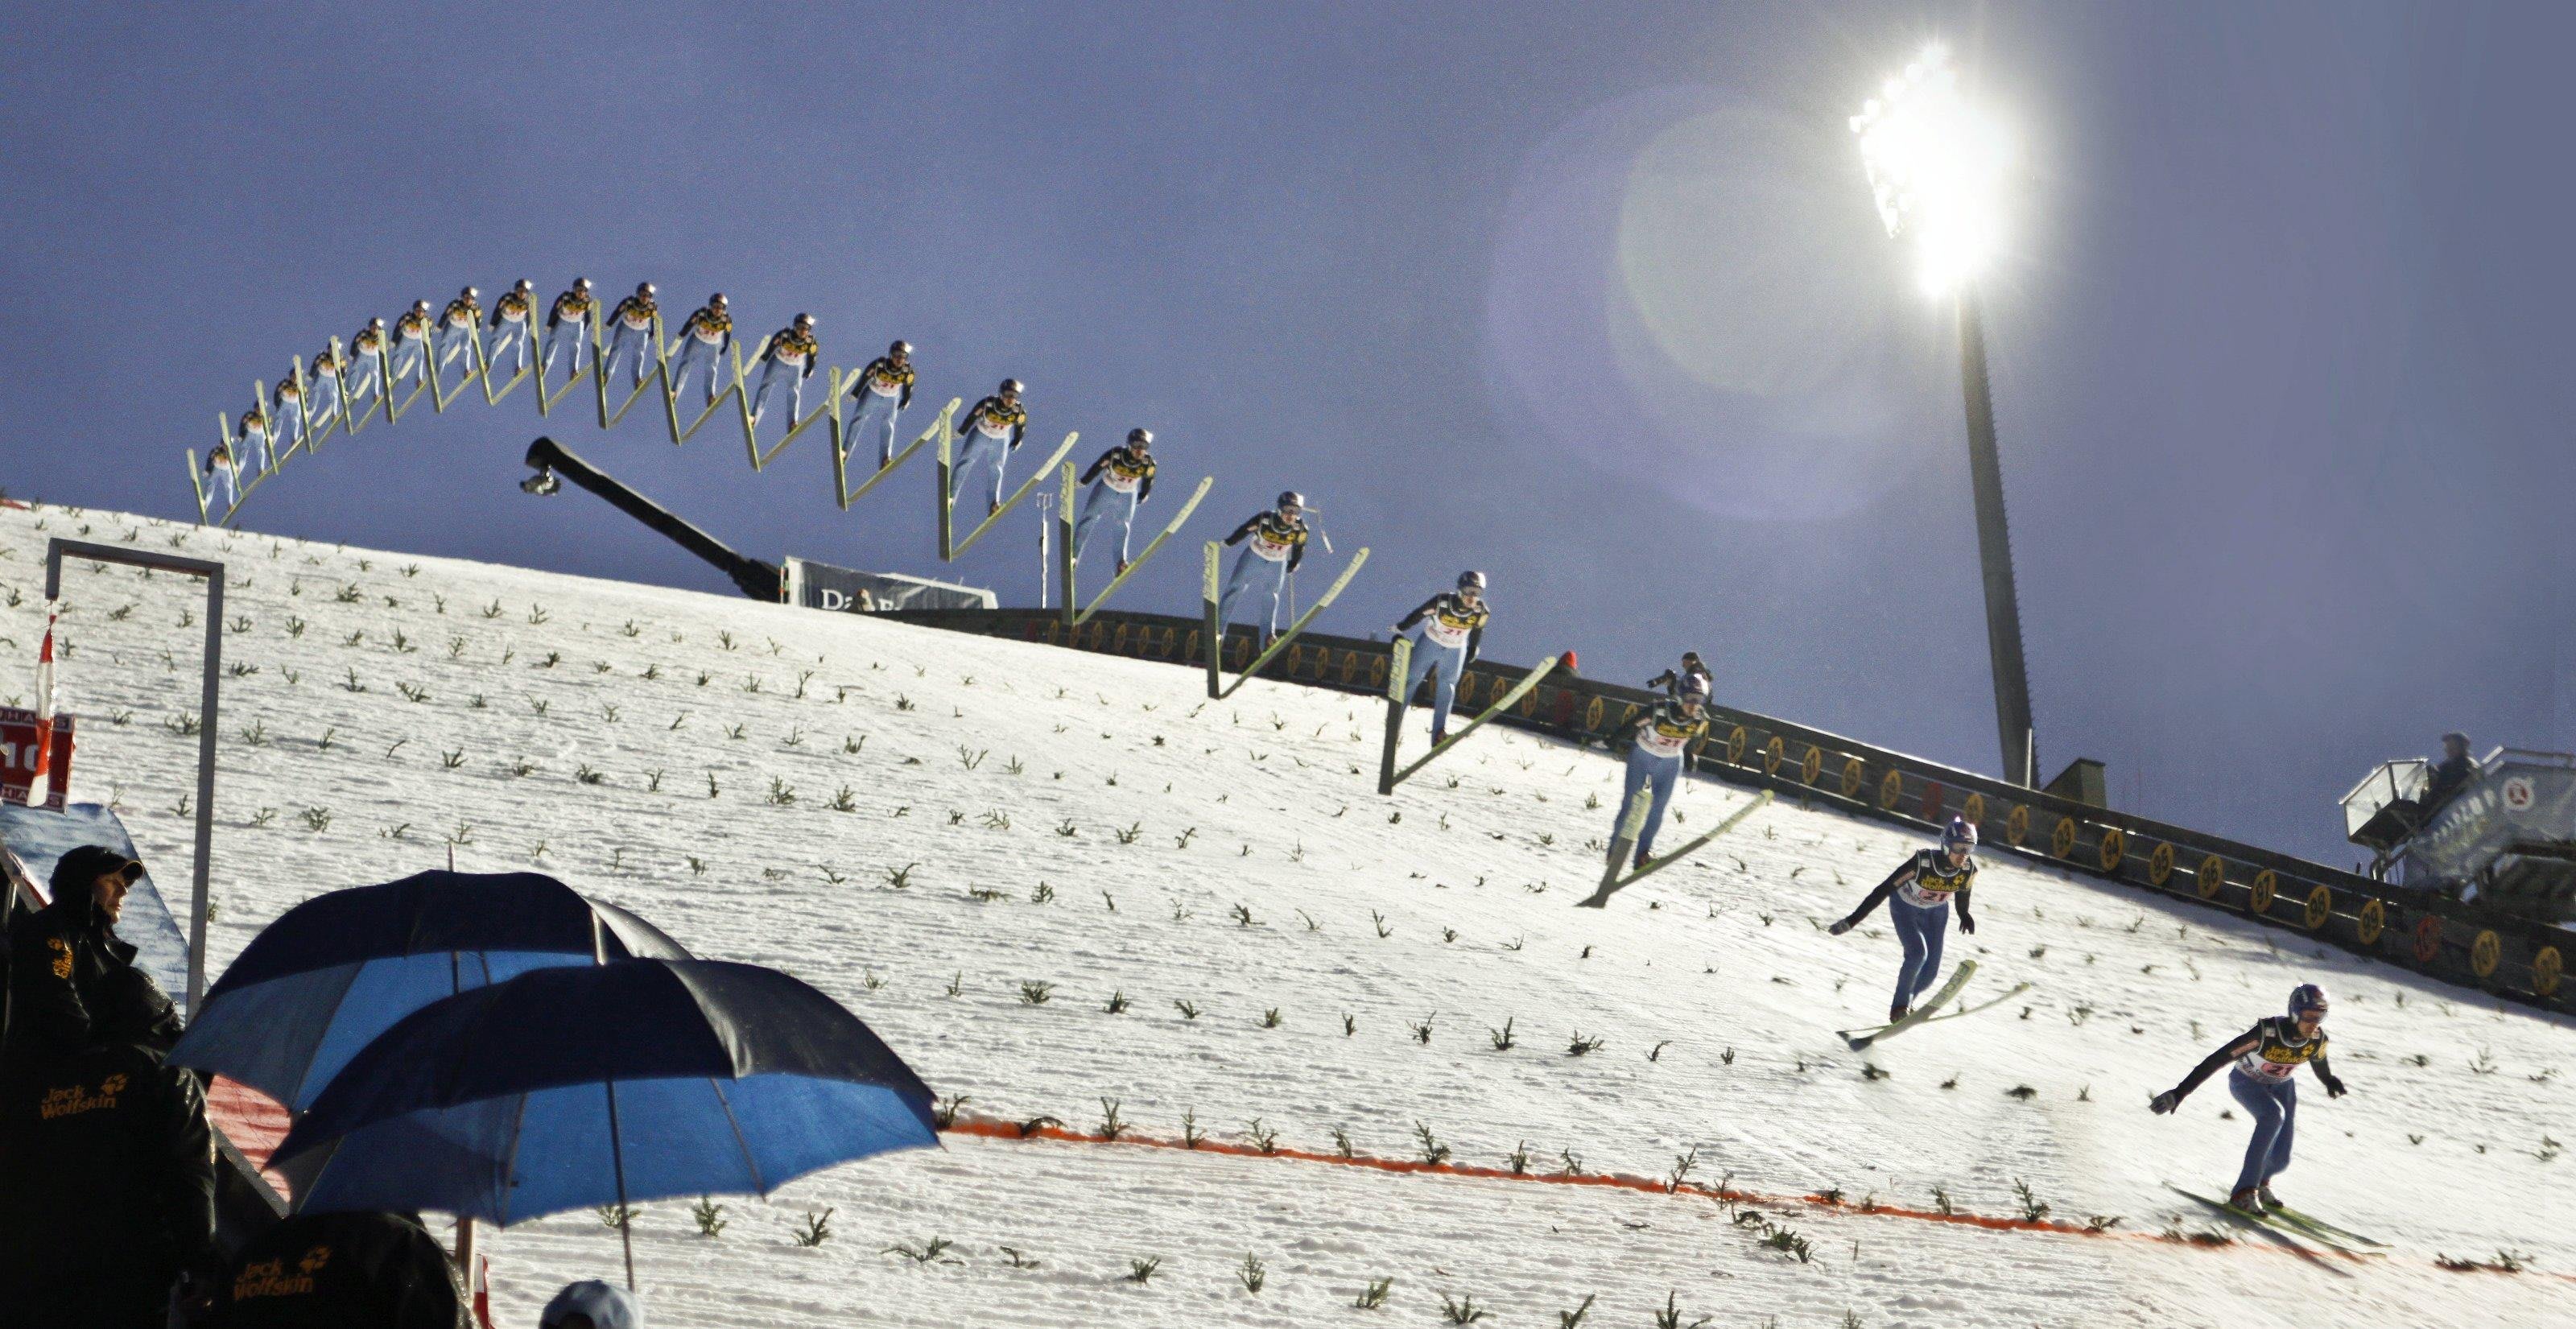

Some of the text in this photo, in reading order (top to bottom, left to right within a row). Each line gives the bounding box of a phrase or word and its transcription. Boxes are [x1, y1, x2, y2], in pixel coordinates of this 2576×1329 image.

[2202, 861, 2219, 892] 96
[2254, 875, 2270, 906] 97
[1924, 891, 1947, 902] 21
[2309, 891, 2326, 922] 98
[2362, 906, 2378, 937] 99
[2268, 1064, 2294, 1076] 21
[41, 1093, 117, 1120] Wolfskin
[42, 1084, 85, 1105] Jack
[236, 1257, 283, 1282] Jack
[233, 1272, 314, 1301] Wolfskin
